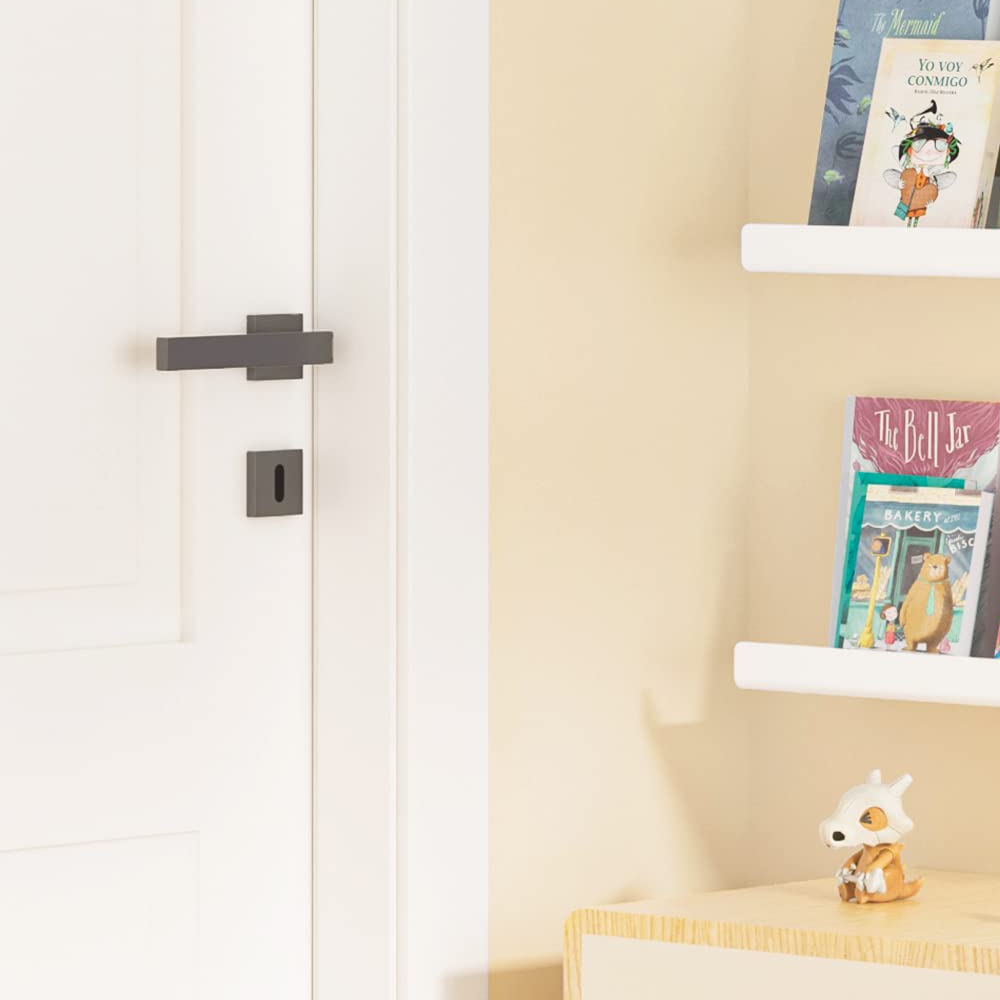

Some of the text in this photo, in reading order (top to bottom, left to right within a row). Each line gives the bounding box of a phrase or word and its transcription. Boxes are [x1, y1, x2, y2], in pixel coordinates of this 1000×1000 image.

[886, 8, 946, 36] Mermaid
[918, 58, 963, 74] YO VOY
[907, 74, 968, 88] CONMIGO
[874, 409, 971, 468] The Bell Jar
[884, 509, 942, 523] BAKERY
